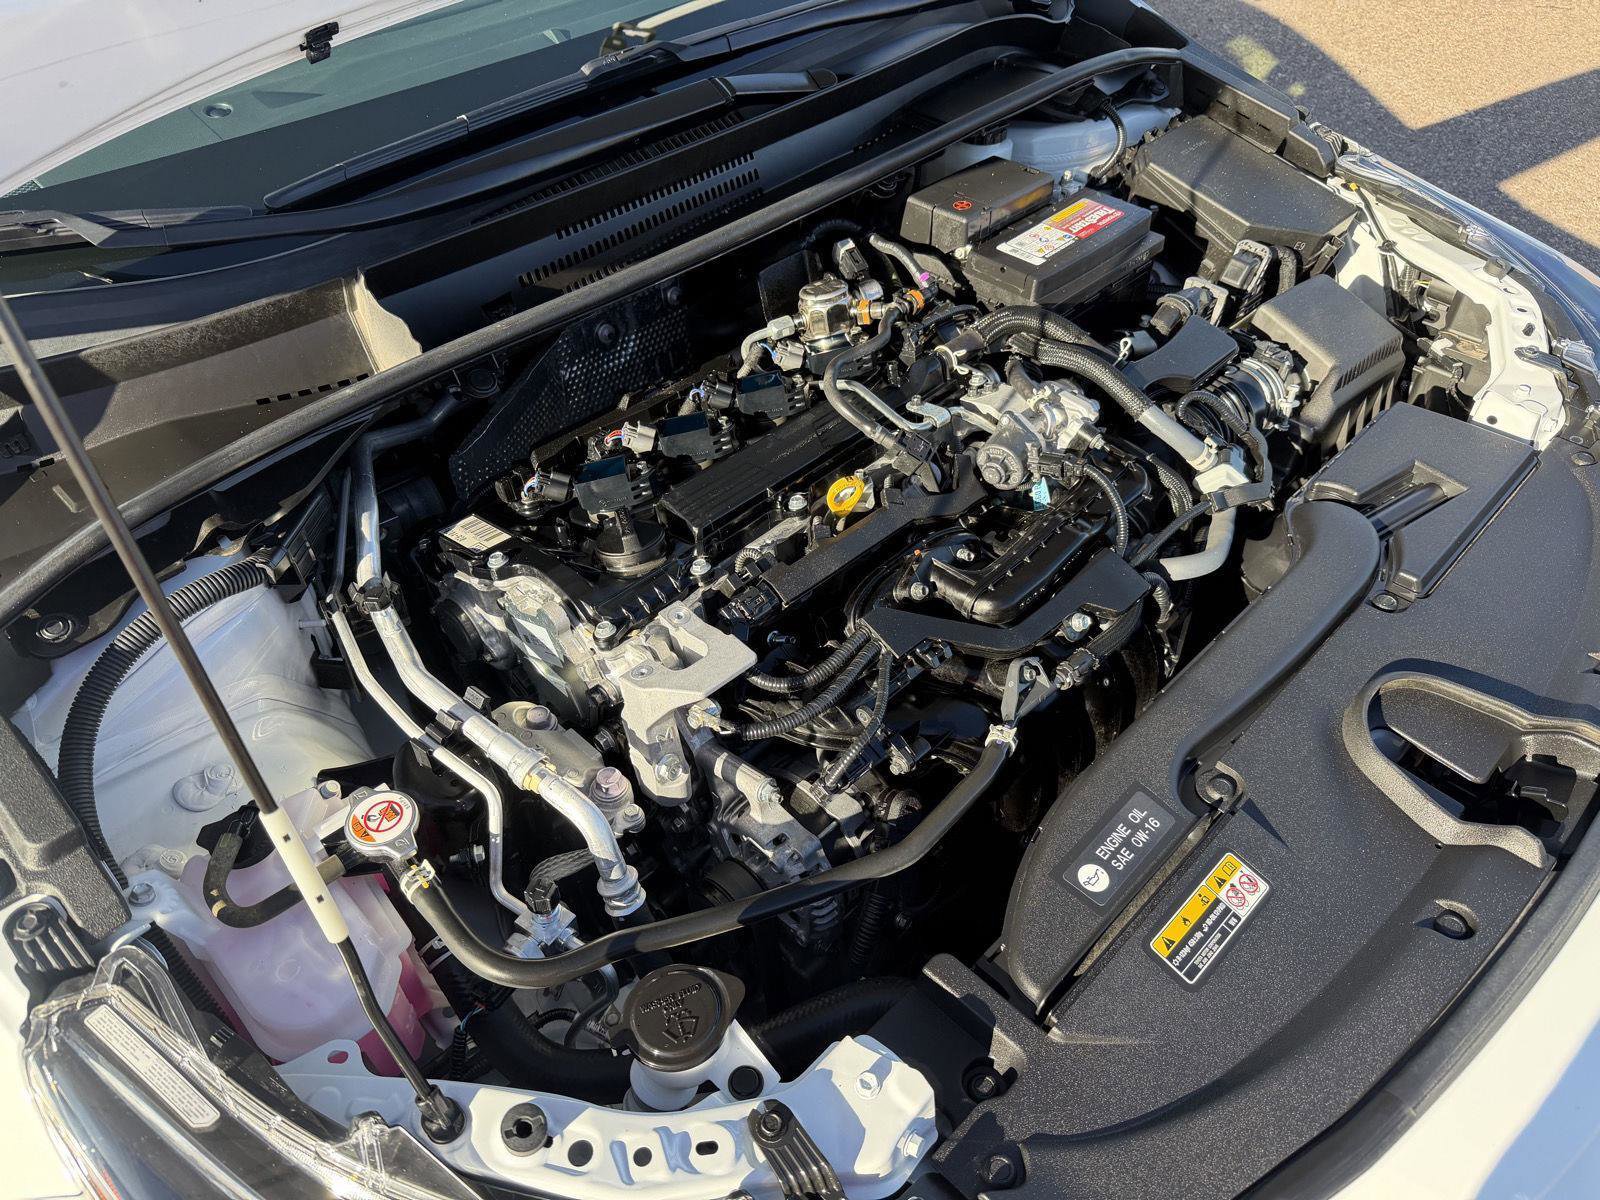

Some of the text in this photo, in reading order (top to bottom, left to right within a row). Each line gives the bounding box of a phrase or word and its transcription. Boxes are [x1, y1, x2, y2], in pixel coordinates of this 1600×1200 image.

[1095, 808, 1148, 860] ENGINE OIL
[1111, 817, 1161, 871] SAE 0W-16
